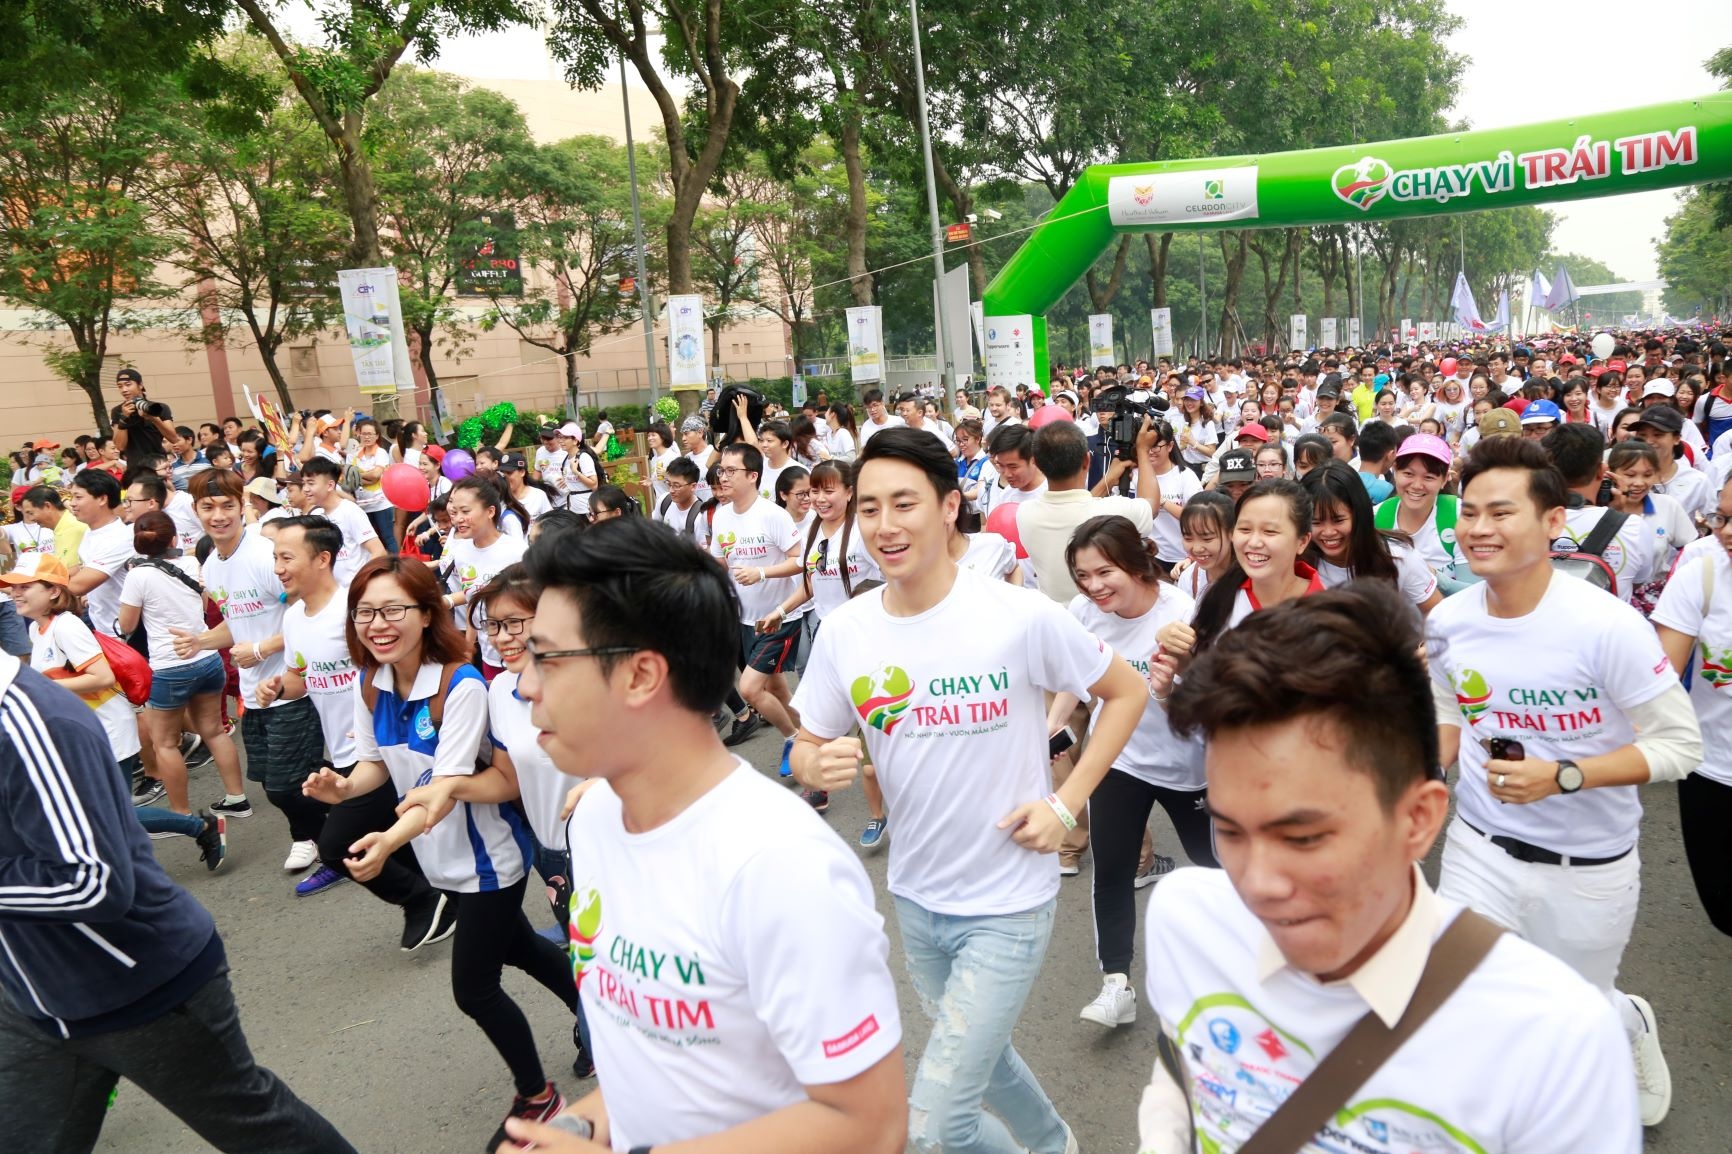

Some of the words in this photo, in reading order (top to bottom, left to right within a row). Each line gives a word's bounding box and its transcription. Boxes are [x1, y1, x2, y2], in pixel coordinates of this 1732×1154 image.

[1392, 166, 1473, 202] CHẠY
[1480, 154, 1511, 190] VÌ
[1522, 138, 1606, 185] TRÁI
[1619, 130, 1694, 171] TIM
[750, 546, 767, 556] TIM
[243, 601, 264, 613] TIM
[308, 673, 328, 689] TRÁI
[330, 671, 357, 687] TIM
[312, 660, 337, 674] CHẠY
[929, 675, 983, 699] CHẠY
[988, 666, 1009, 690] VÌ
[1509, 687, 1567, 711] CHẠY
[1573, 683, 1598, 702] VÌ
[911, 700, 960, 726] TRÁI
[966, 698, 1008, 723] TIM
[1492, 708, 1547, 732] TRÁI
[1552, 706, 1601, 732] TIM
[610, 934, 666, 984] CHẠY
[674, 951, 705, 986] VÌ
[597, 965, 639, 1018] TRÁI
[643, 994, 716, 1030] TIM
